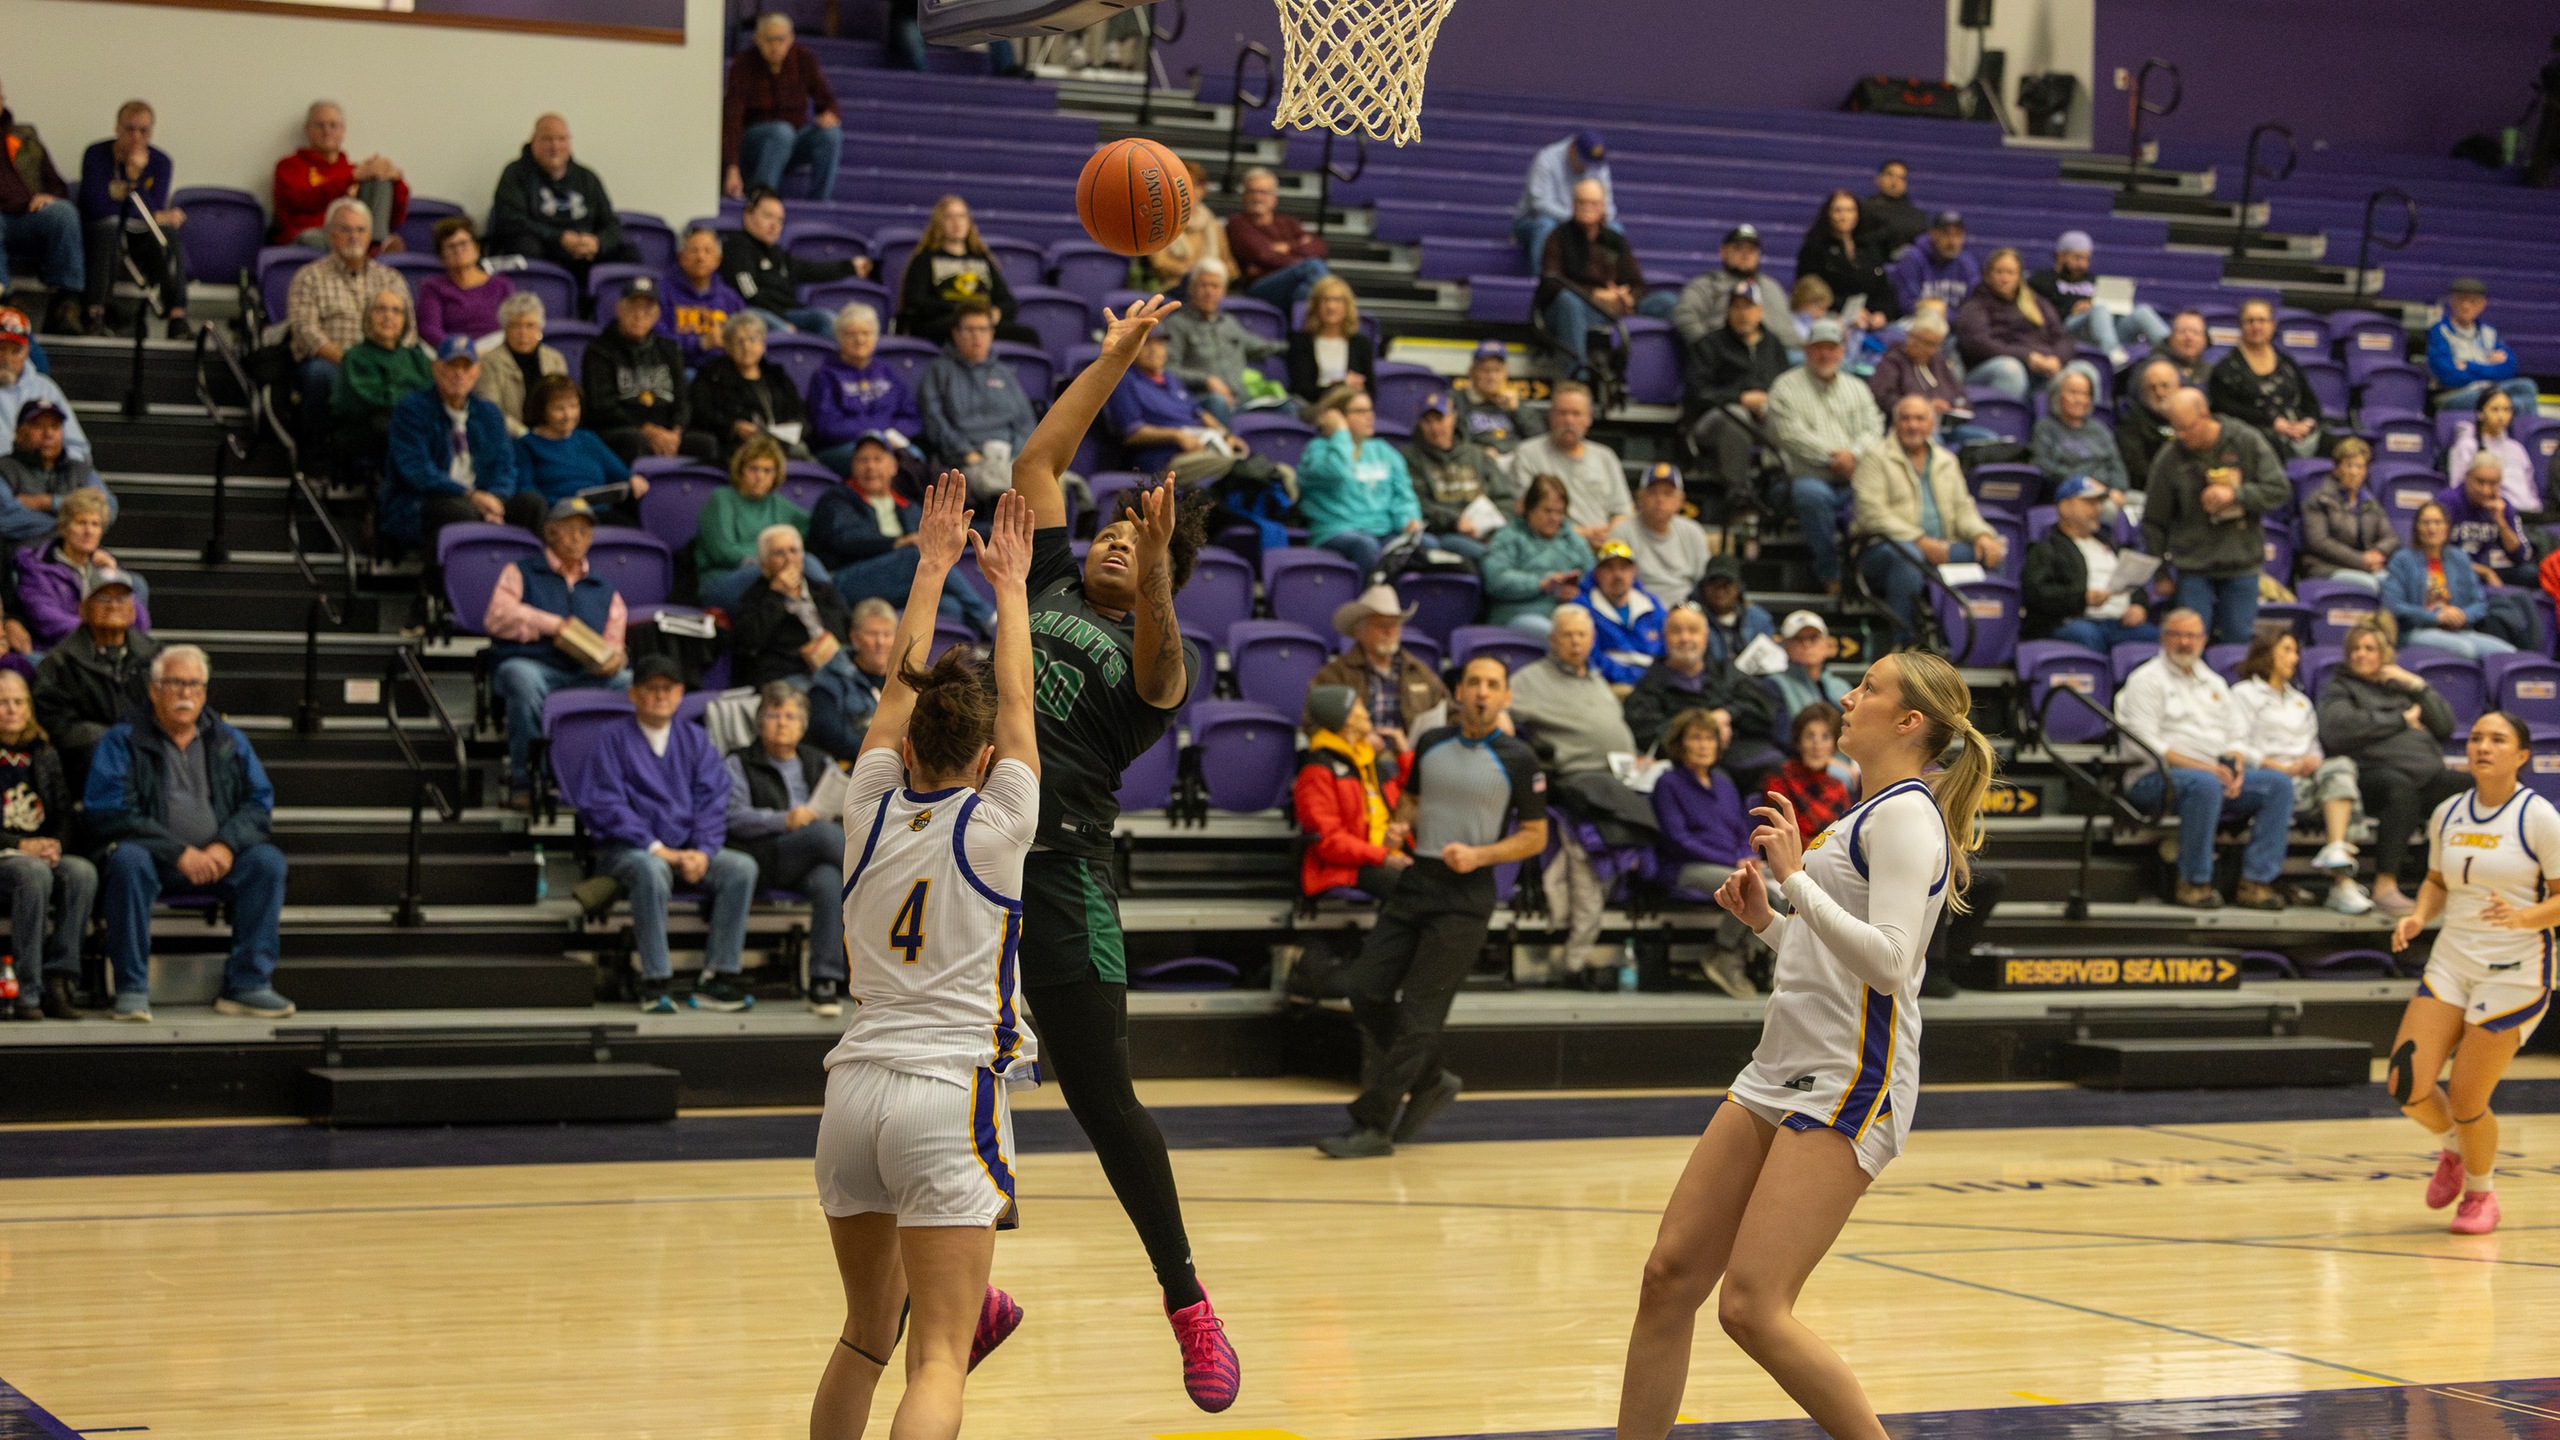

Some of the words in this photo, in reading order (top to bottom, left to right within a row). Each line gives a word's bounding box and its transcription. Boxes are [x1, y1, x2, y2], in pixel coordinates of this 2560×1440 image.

[1140, 167, 1165, 244] SPALDING
[2463, 856, 2474, 884] 1
[888, 878, 933, 965] 4
[2004, 959, 2120, 985] RESERVED
[2122, 957, 2214, 984] SEATING
